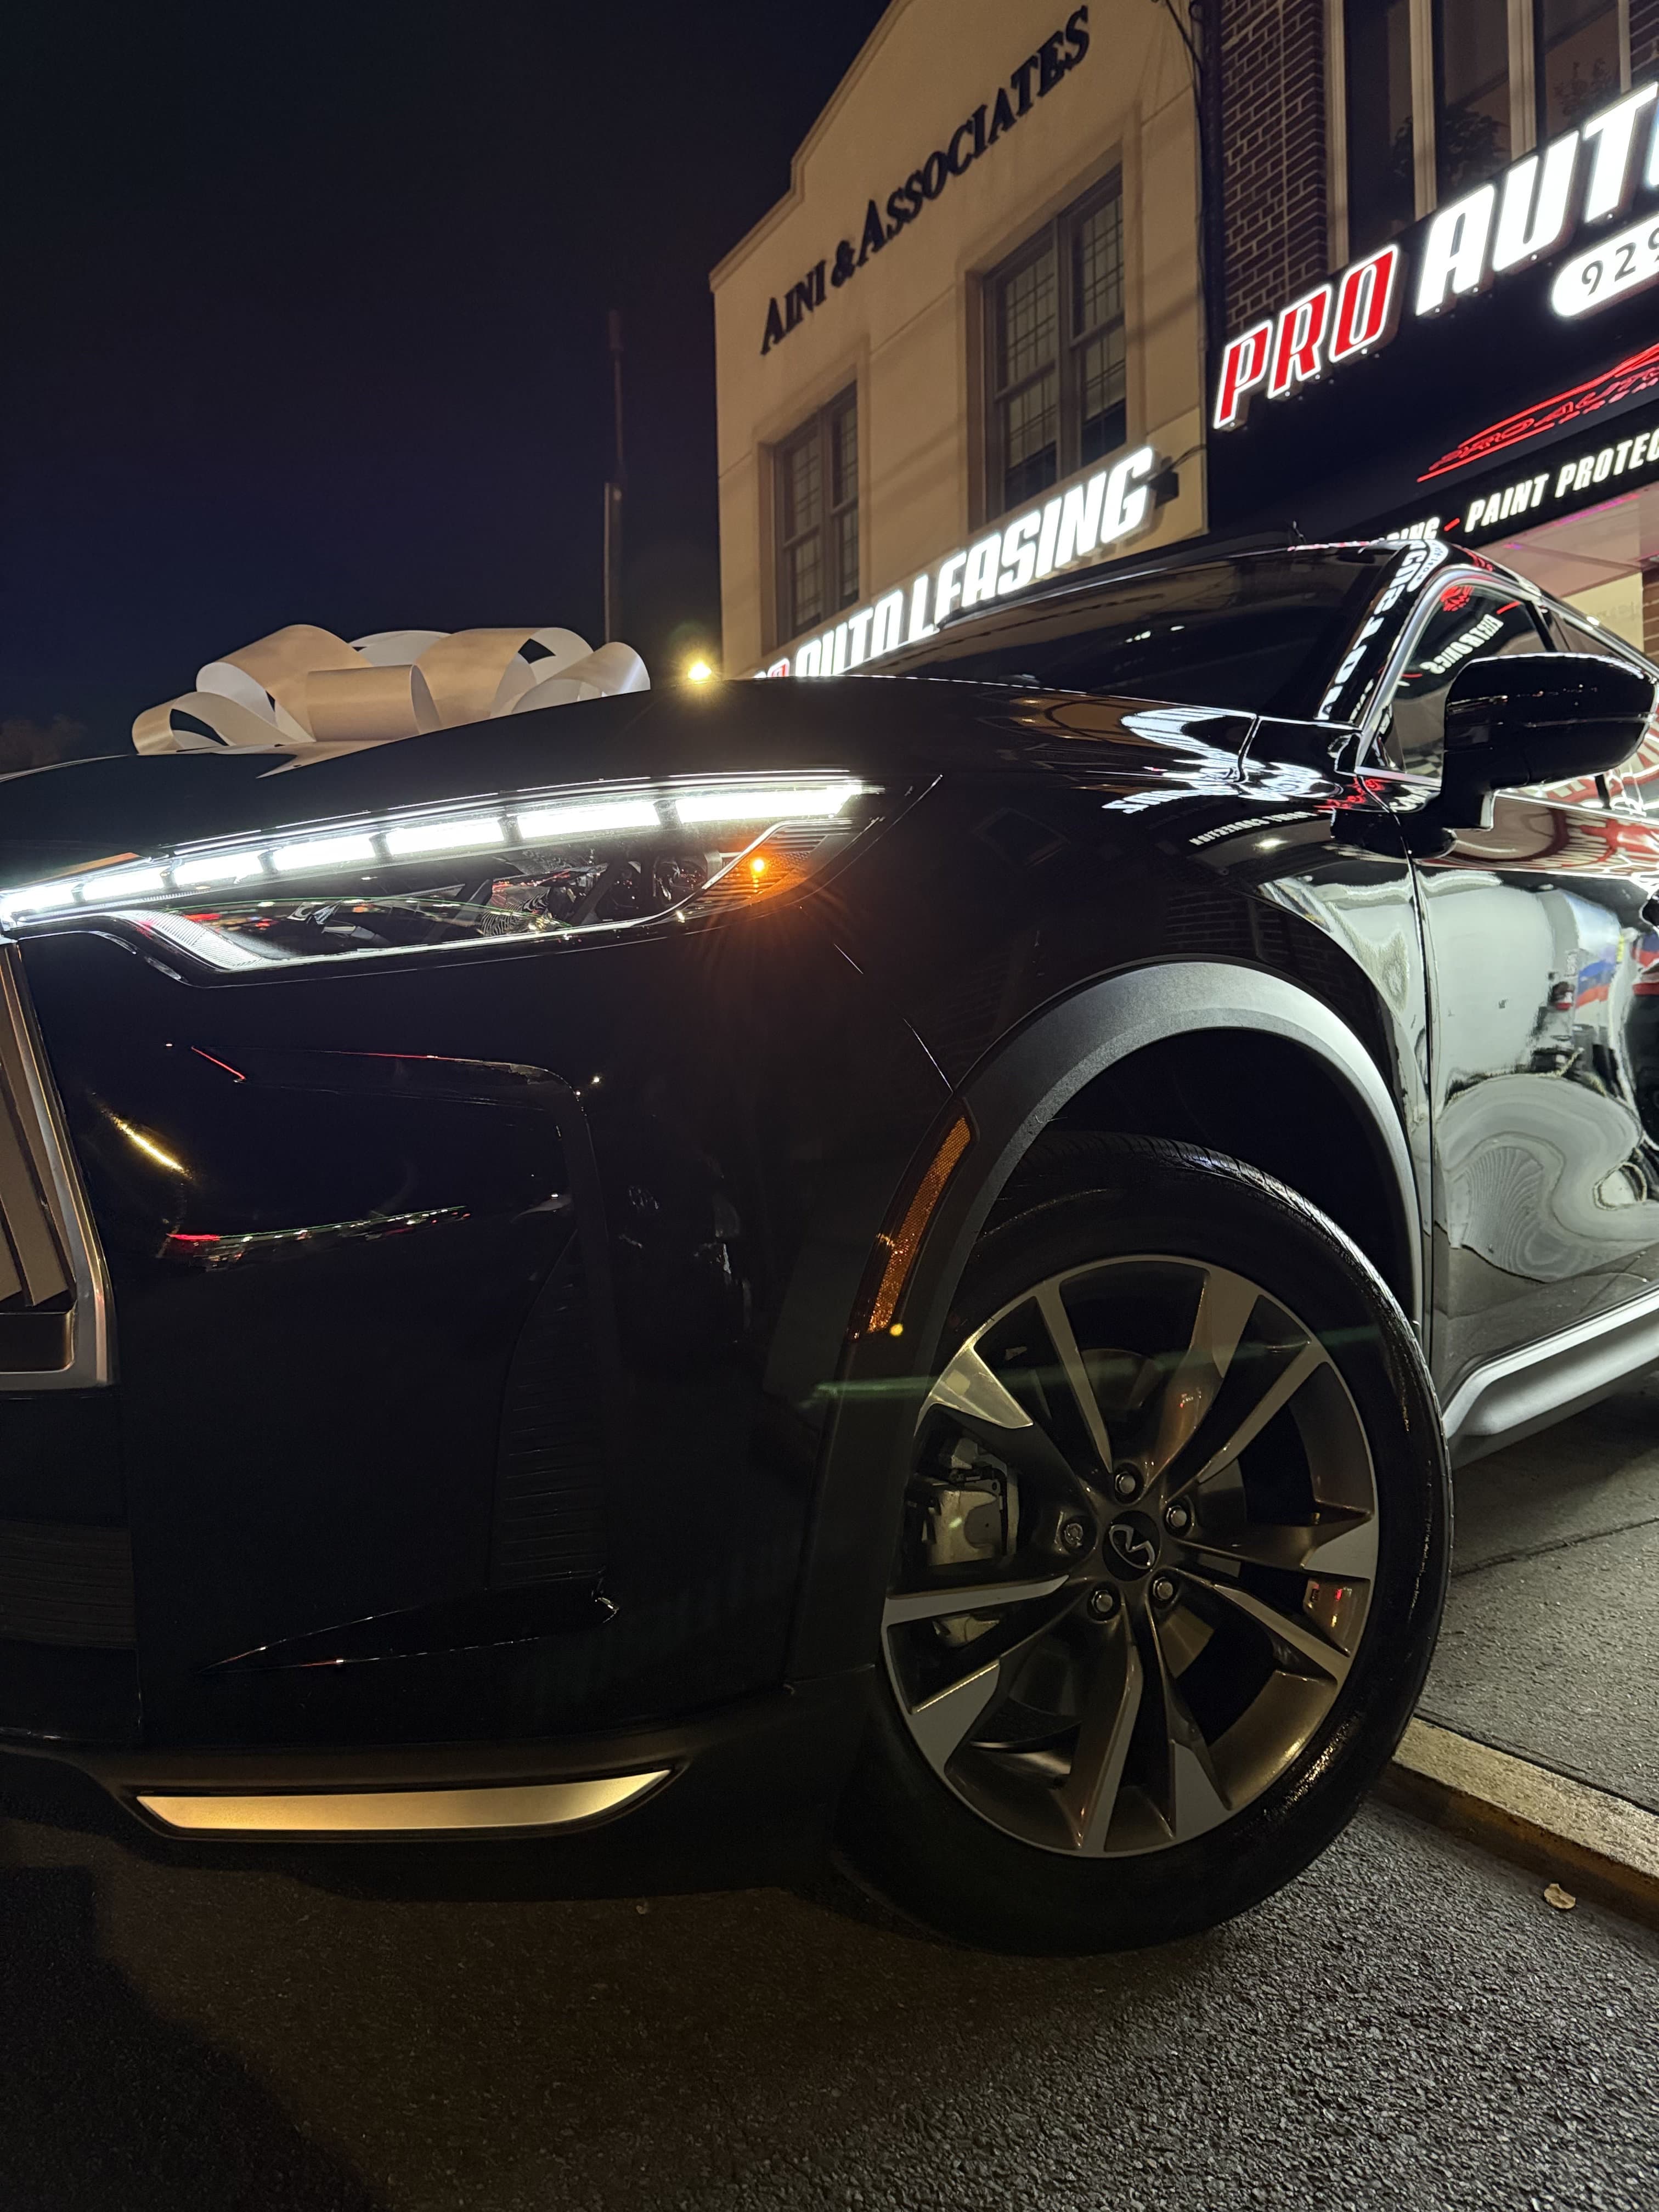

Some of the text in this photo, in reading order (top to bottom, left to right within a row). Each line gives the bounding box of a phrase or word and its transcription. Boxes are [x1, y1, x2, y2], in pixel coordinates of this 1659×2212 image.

[760, 5, 1090, 356] AINI & ASSOCIATES
[1214, 81, 1659, 430] PRO AUT
[907, 447, 1154, 642] LEASING
[1464, 473, 1549, 533] PAINT
